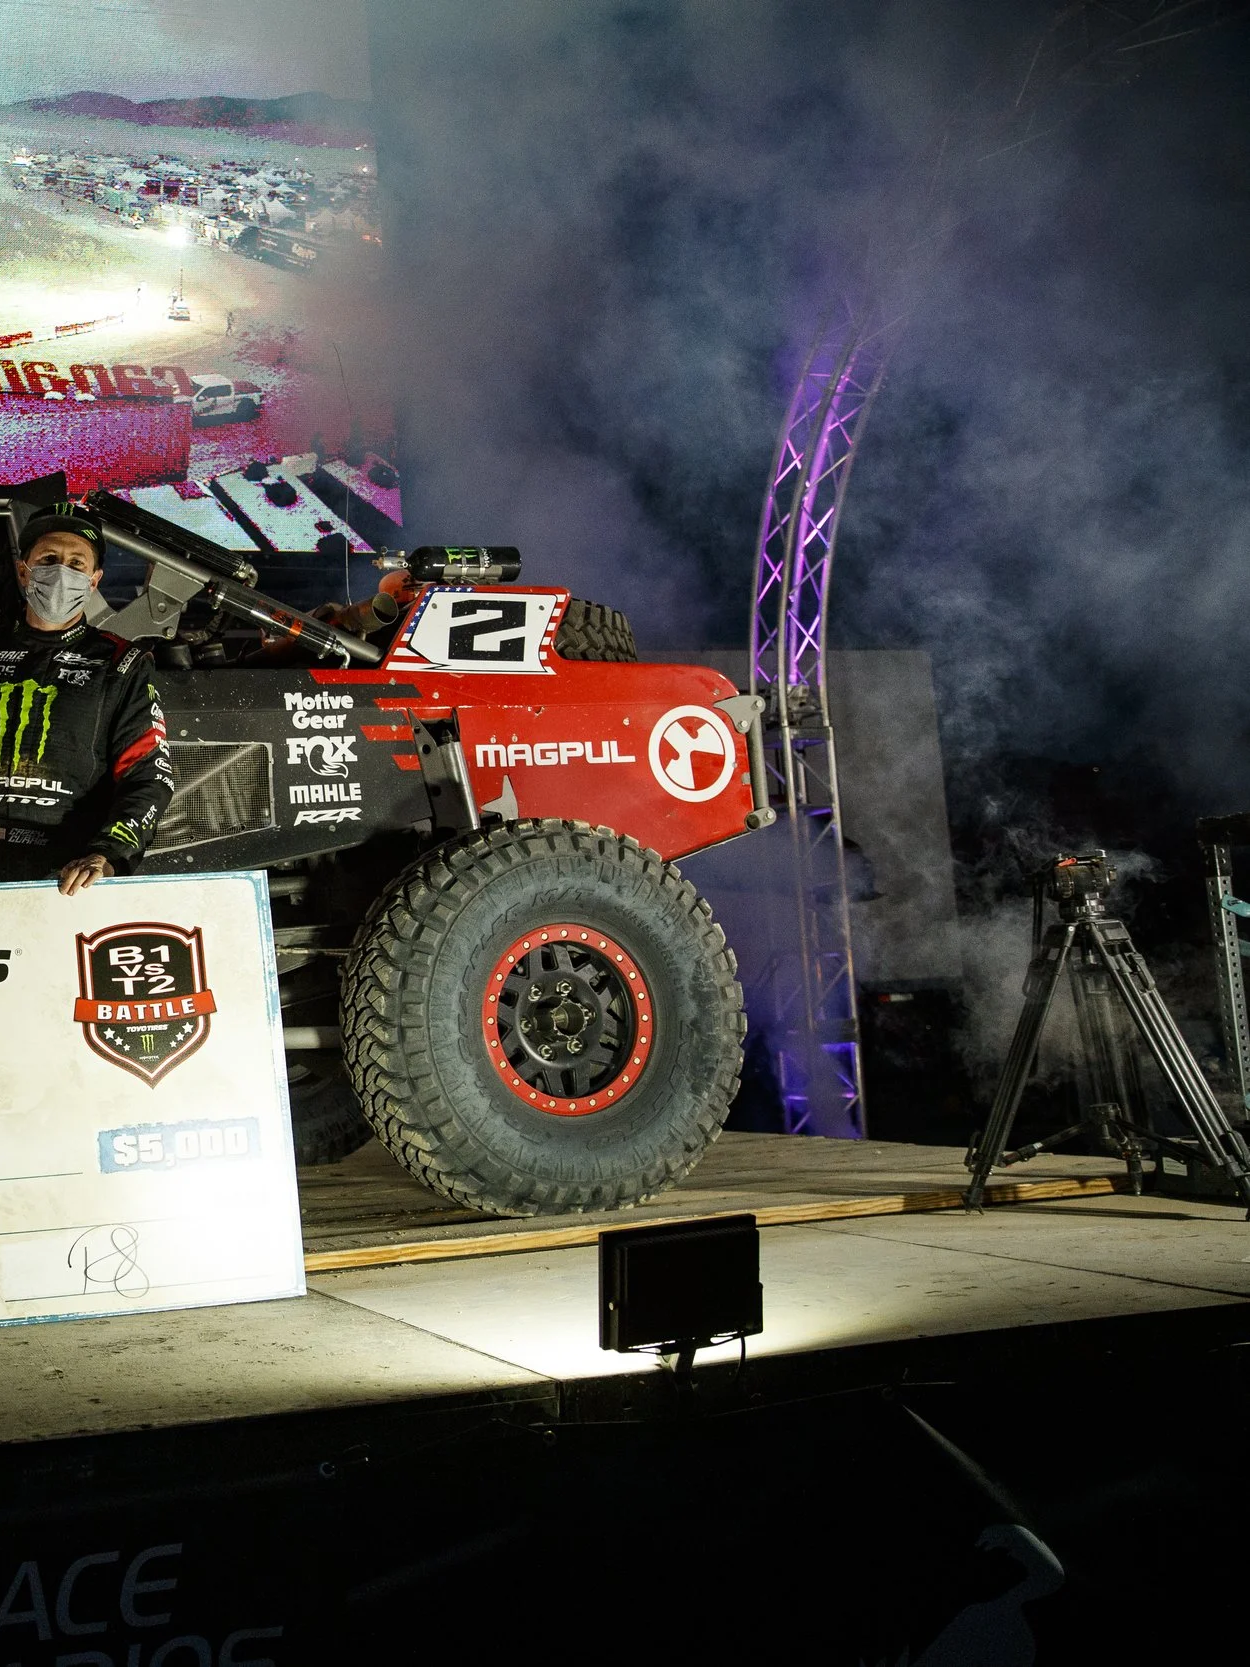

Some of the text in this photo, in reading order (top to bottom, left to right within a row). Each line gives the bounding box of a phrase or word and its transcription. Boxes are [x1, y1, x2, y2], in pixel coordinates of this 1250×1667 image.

[450, 600, 526, 662] 2
[58, 667, 93, 686] FOX
[284, 691, 354, 712] Motive
[292, 710, 347, 731] Gear
[286, 735, 358, 779] FOX
[475, 741, 636, 768] MAGPUL
[289, 783, 362, 804] MAHLE
[293, 806, 363, 827] RZR
[108, 944, 171, 966] B1
[119, 961, 166, 977] VS
[111, 974, 177, 996] T2
[96, 998, 197, 1022] BATTLE
[112, 1124, 249, 1167] $5,000
